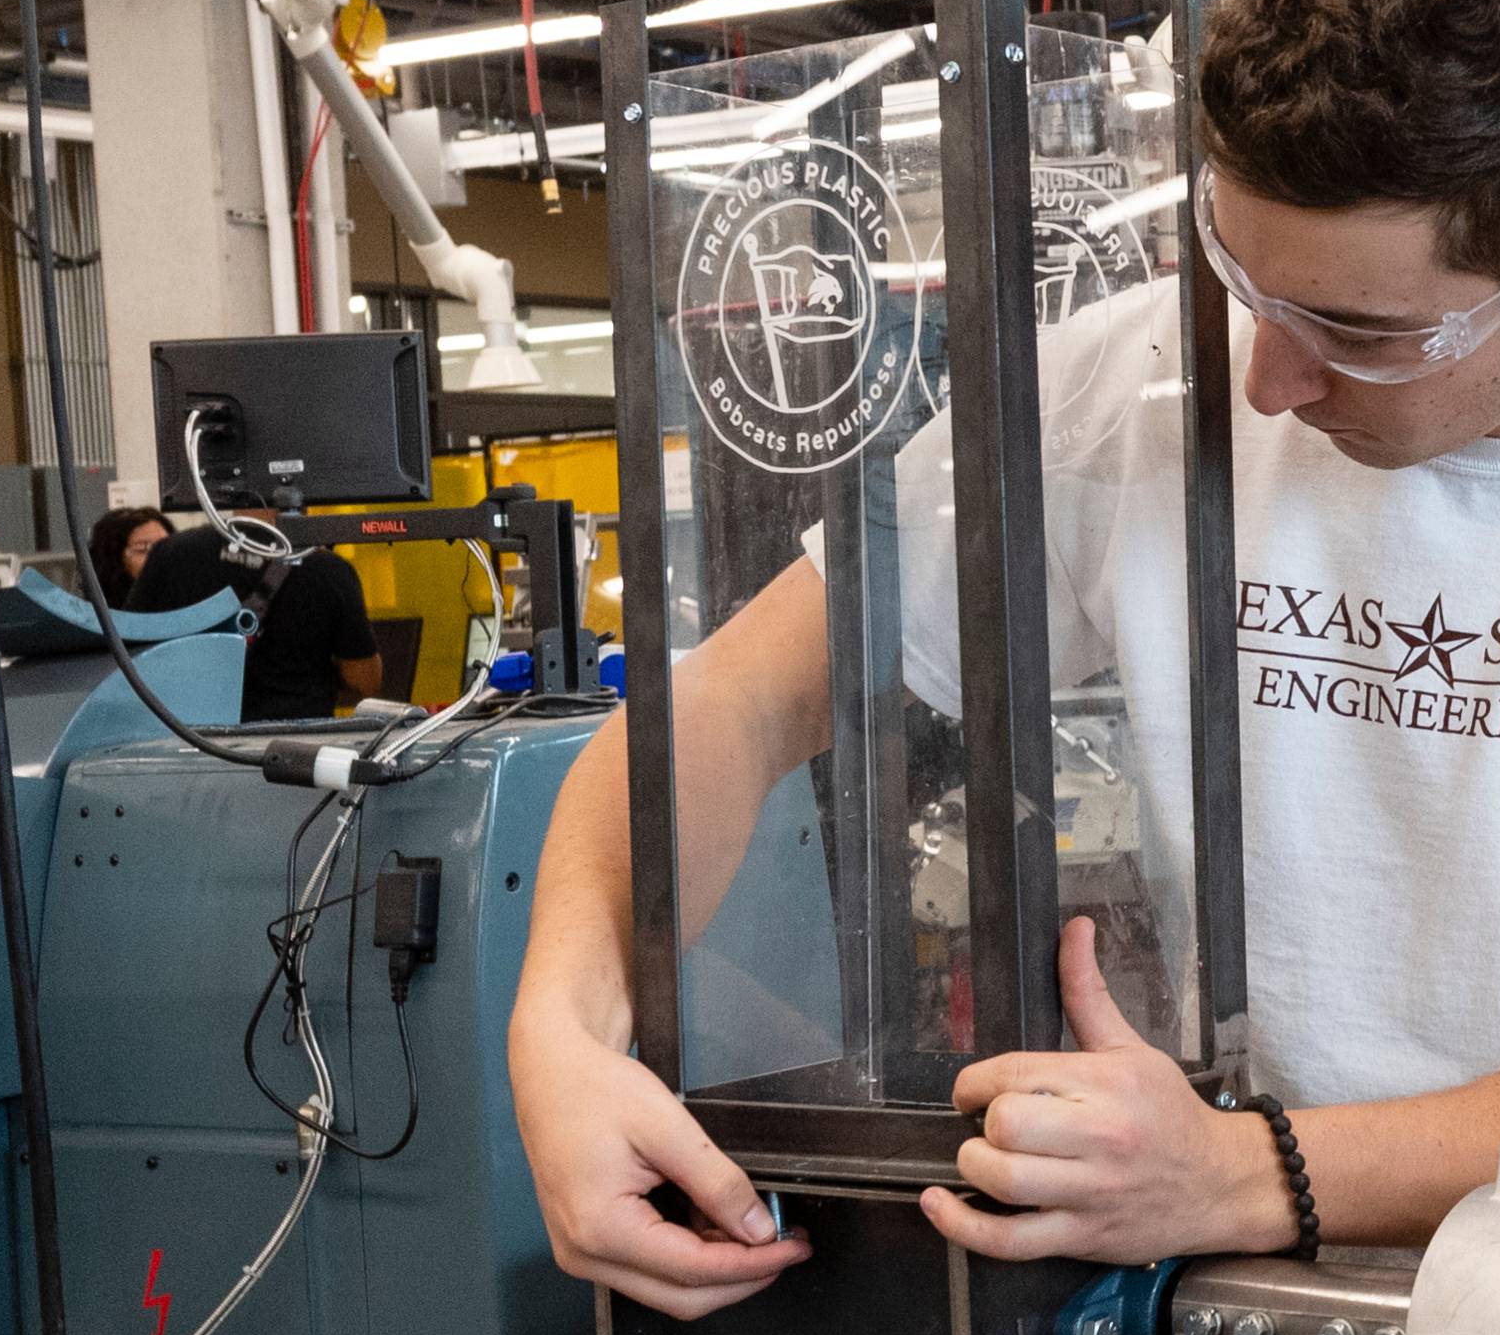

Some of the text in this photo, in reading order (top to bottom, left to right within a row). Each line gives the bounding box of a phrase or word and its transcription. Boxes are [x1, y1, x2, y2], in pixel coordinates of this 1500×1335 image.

[697, 160, 891, 276] PRECIOUS PLASTIC
[708, 348, 898, 455] Bobcats Repurpose
[361, 520, 408, 534] NEWALL
[1236, 580, 1383, 649] EXAS
